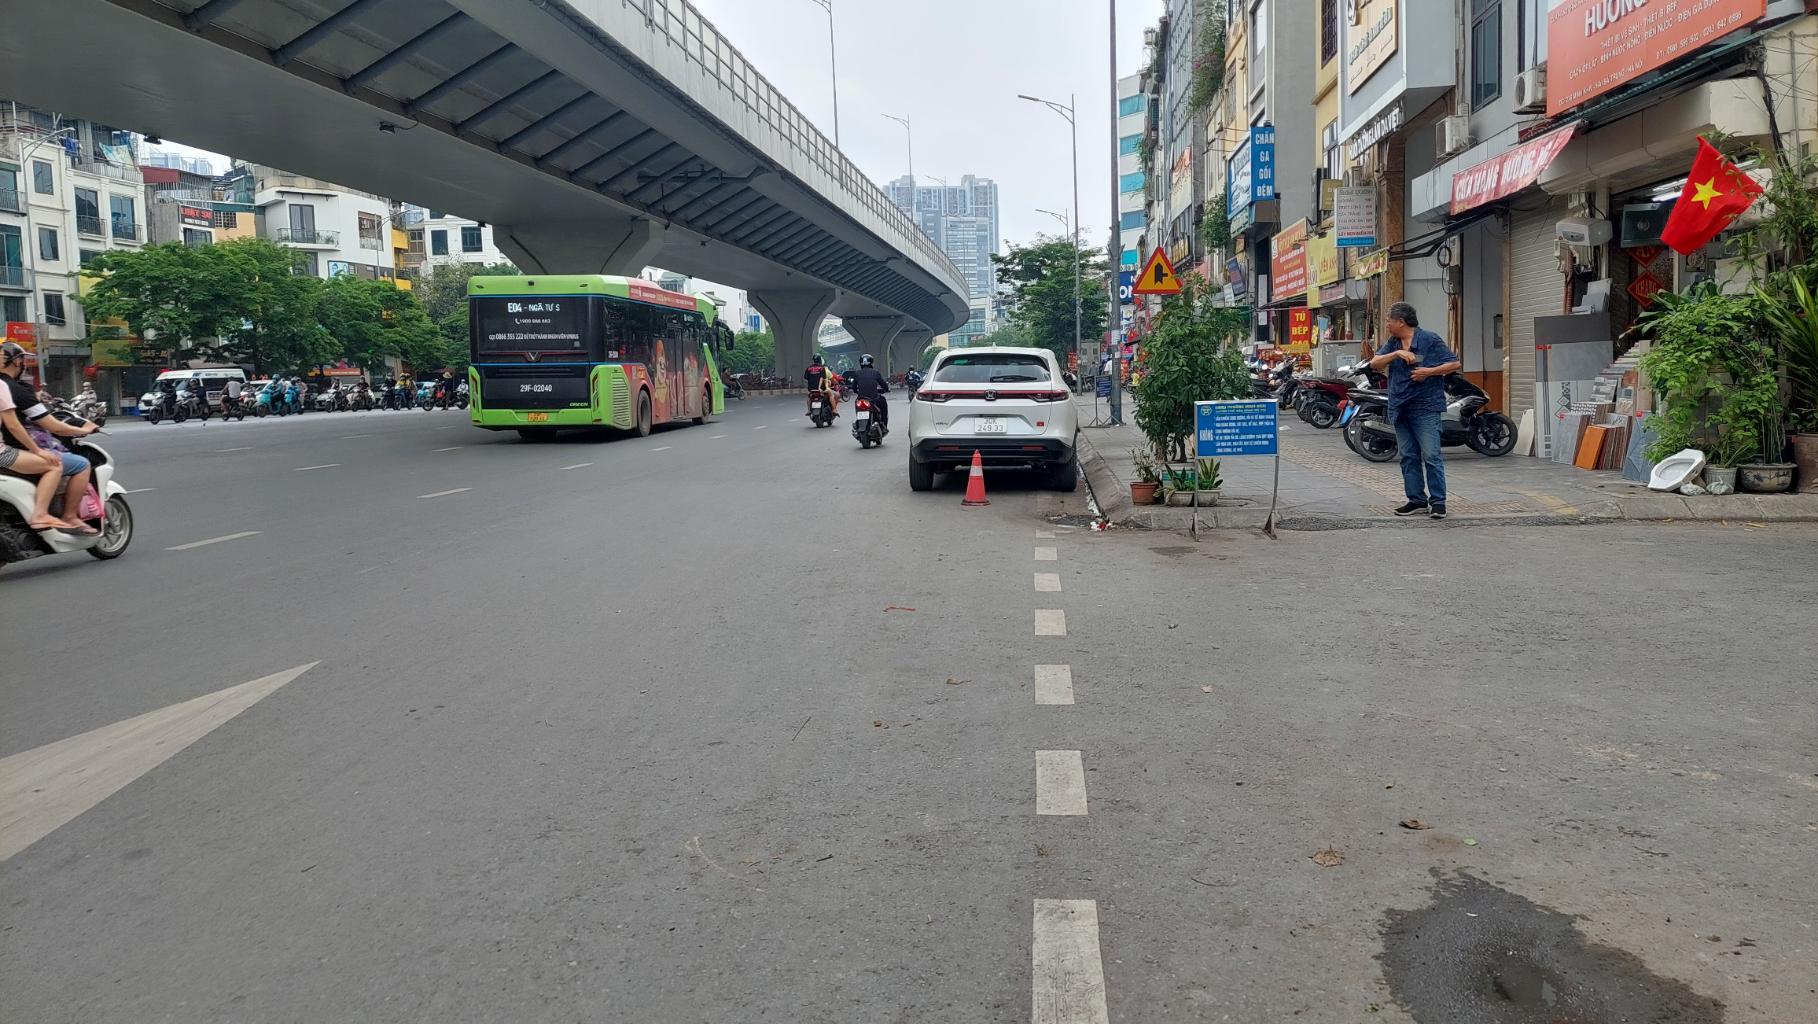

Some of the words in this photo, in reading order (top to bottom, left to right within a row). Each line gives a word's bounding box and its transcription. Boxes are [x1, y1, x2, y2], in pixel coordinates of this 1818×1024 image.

[1255, 131, 1275, 145] CHĂN
[1259, 150, 1270, 162] GA
[1258, 165, 1272, 179] GỐI
[507, 303, 522, 312] E04
[528, 303, 544, 312] NGÃ
[1295, 310, 1306, 322] TỦ
